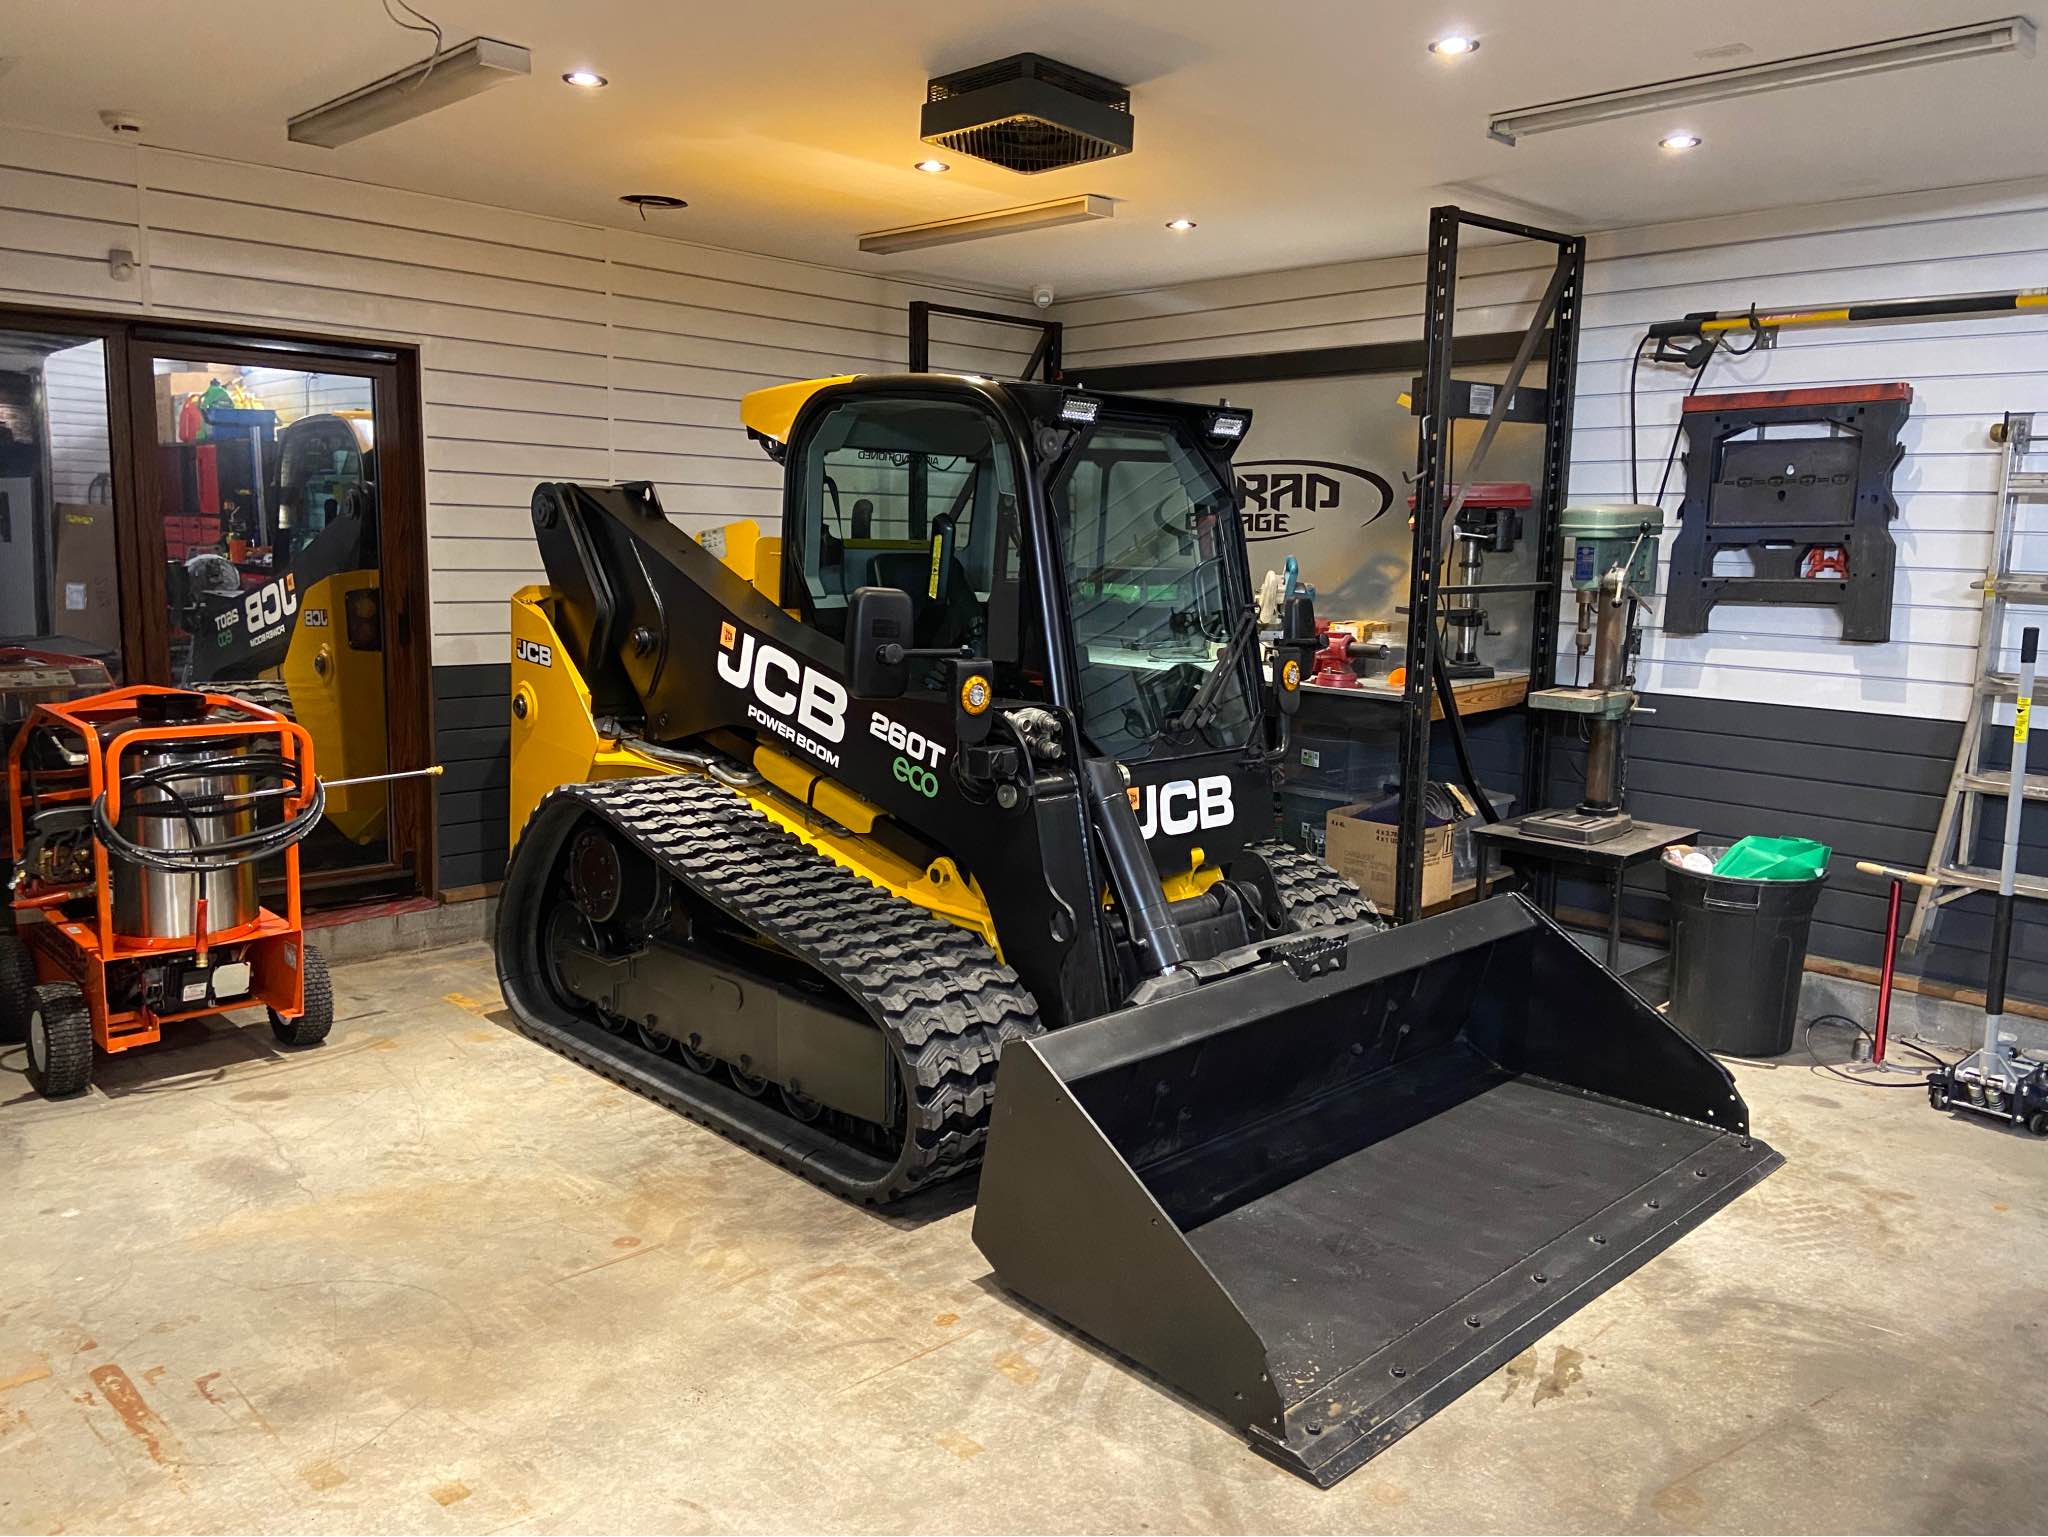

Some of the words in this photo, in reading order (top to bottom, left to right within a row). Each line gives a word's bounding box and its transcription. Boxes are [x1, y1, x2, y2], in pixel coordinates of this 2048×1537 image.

[517, 640, 552, 667] JCB
[717, 632, 848, 743] JCB
[748, 704, 795, 742] POWER
[796, 735, 840, 768] BOOM
[869, 711, 947, 769] 260T
[893, 756, 939, 798] eco
[1139, 775, 1235, 840] JCB
